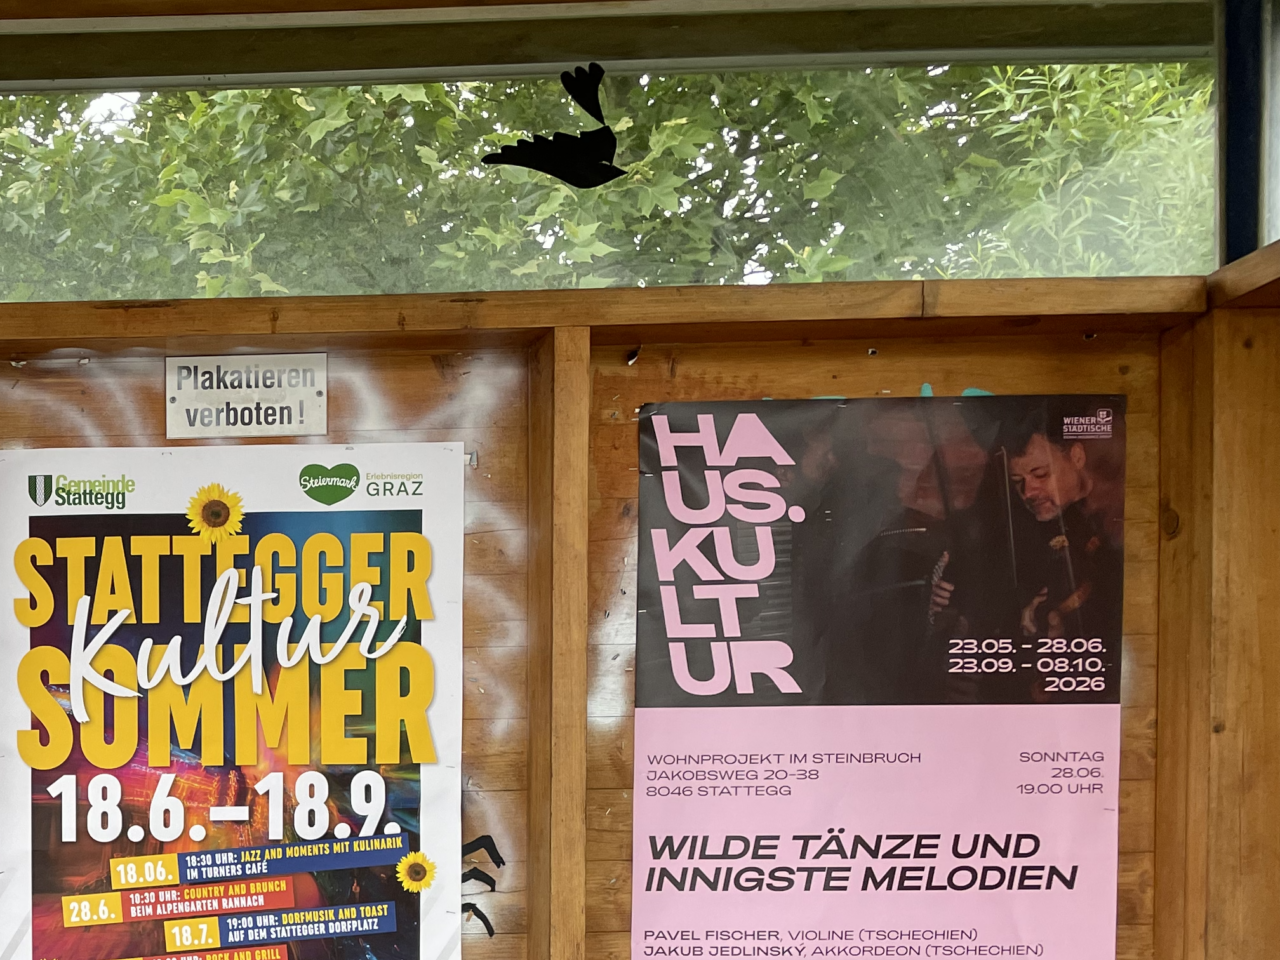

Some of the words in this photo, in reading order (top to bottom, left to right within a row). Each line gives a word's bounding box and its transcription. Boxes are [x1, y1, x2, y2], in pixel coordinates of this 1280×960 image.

[177, 364, 315, 390] Plakatieren
[1063, 416, 1097, 424] WIENER
[56, 474, 136, 493] Gemeinde
[300, 476, 358, 491] Steiermark
[366, 472, 424, 481] Erlebnisregion
[366, 481, 424, 497] GRAZ
[55, 487, 125, 510] Stattegg
[13, 531, 435, 628] STATTEGGER
[70, 565, 407, 725] Kultur
[948, 638, 1017, 654] 23.05.
[1036, 638, 1107, 653] 28.06.
[948, 658, 1017, 673] 23.09.
[1036, 657, 1106, 672] 08.10.
[1044, 677, 1106, 692] 2026
[17, 641, 439, 770] SOMMER
[647, 754, 785, 765] WOHNPROJEKT
[789, 753, 808, 764] IM
[812, 752, 922, 764] STEINBRUCH
[1019, 751, 1105, 763] SONNTAG
[646, 770, 759, 781] JAKOBSWEG
[1051, 767, 1105, 779] 28.06.
[646, 785, 694, 797] 8046
[697, 785, 792, 797] STATTEGG
[1016, 783, 1063, 794] 19.00
[1067, 783, 1104, 794] UHR
[185, 853, 213, 867] 18:30
[215, 852, 238, 865] UHR:
[240, 850, 261, 862] JAZZ
[264, 848, 283, 861] AND
[286, 844, 330, 859] MOMENTS
[333, 841, 350, 854] MIT
[353, 836, 403, 852] KULINARIK
[648, 834, 780, 860] WILDE
[791, 828, 941, 860] TÄNZE
[951, 833, 1041, 859] UND
[116, 861, 173, 885] 18.06.
[187, 868, 199, 880] IM
[201, 864, 243, 879] TURNERS
[246, 859, 268, 876] CAFÉ
[645, 866, 852, 892] INNIGSTE
[860, 865, 1079, 891] MELODIEN
[130, 892, 156, 905] 10:30
[158, 890, 181, 903] UHR:
[184, 886, 225, 900] COUNTRY
[228, 883, 247, 896] AND
[250, 880, 287, 894] BRUNCH
[70, 899, 116, 923] 28.6.
[131, 905, 153, 918] BEIM
[156, 899, 219, 915] ALPENGARTEN
[222, 895, 264, 910] RANNACH
[227, 916, 254, 930] 19:00
[256, 914, 279, 927] UHR:
[282, 909, 335, 925] DORFMUSIK
[338, 908, 357, 921] AND
[360, 904, 388, 917] TOAST
[171, 923, 214, 947] 18.7.
[228, 930, 245, 943] AUF
[248, 928, 267, 941] DEM
[270, 923, 326, 939] STATTEGGER
[329, 918, 379, 934] DORFPLATZ
[643, 930, 701, 941] PAVEL
[705, 930, 783, 943] FISCHER,
[787, 929, 854, 941] VIOLINE
[858, 928, 978, 942] (TSCHECHIEN)
[643, 945, 704, 957] JAKUB
[708, 942, 808, 958] JEDLINSKÝ,
[811, 945, 921, 957] AKKORDEON
[924, 943, 1045, 957] (TSCHECHIEN)
